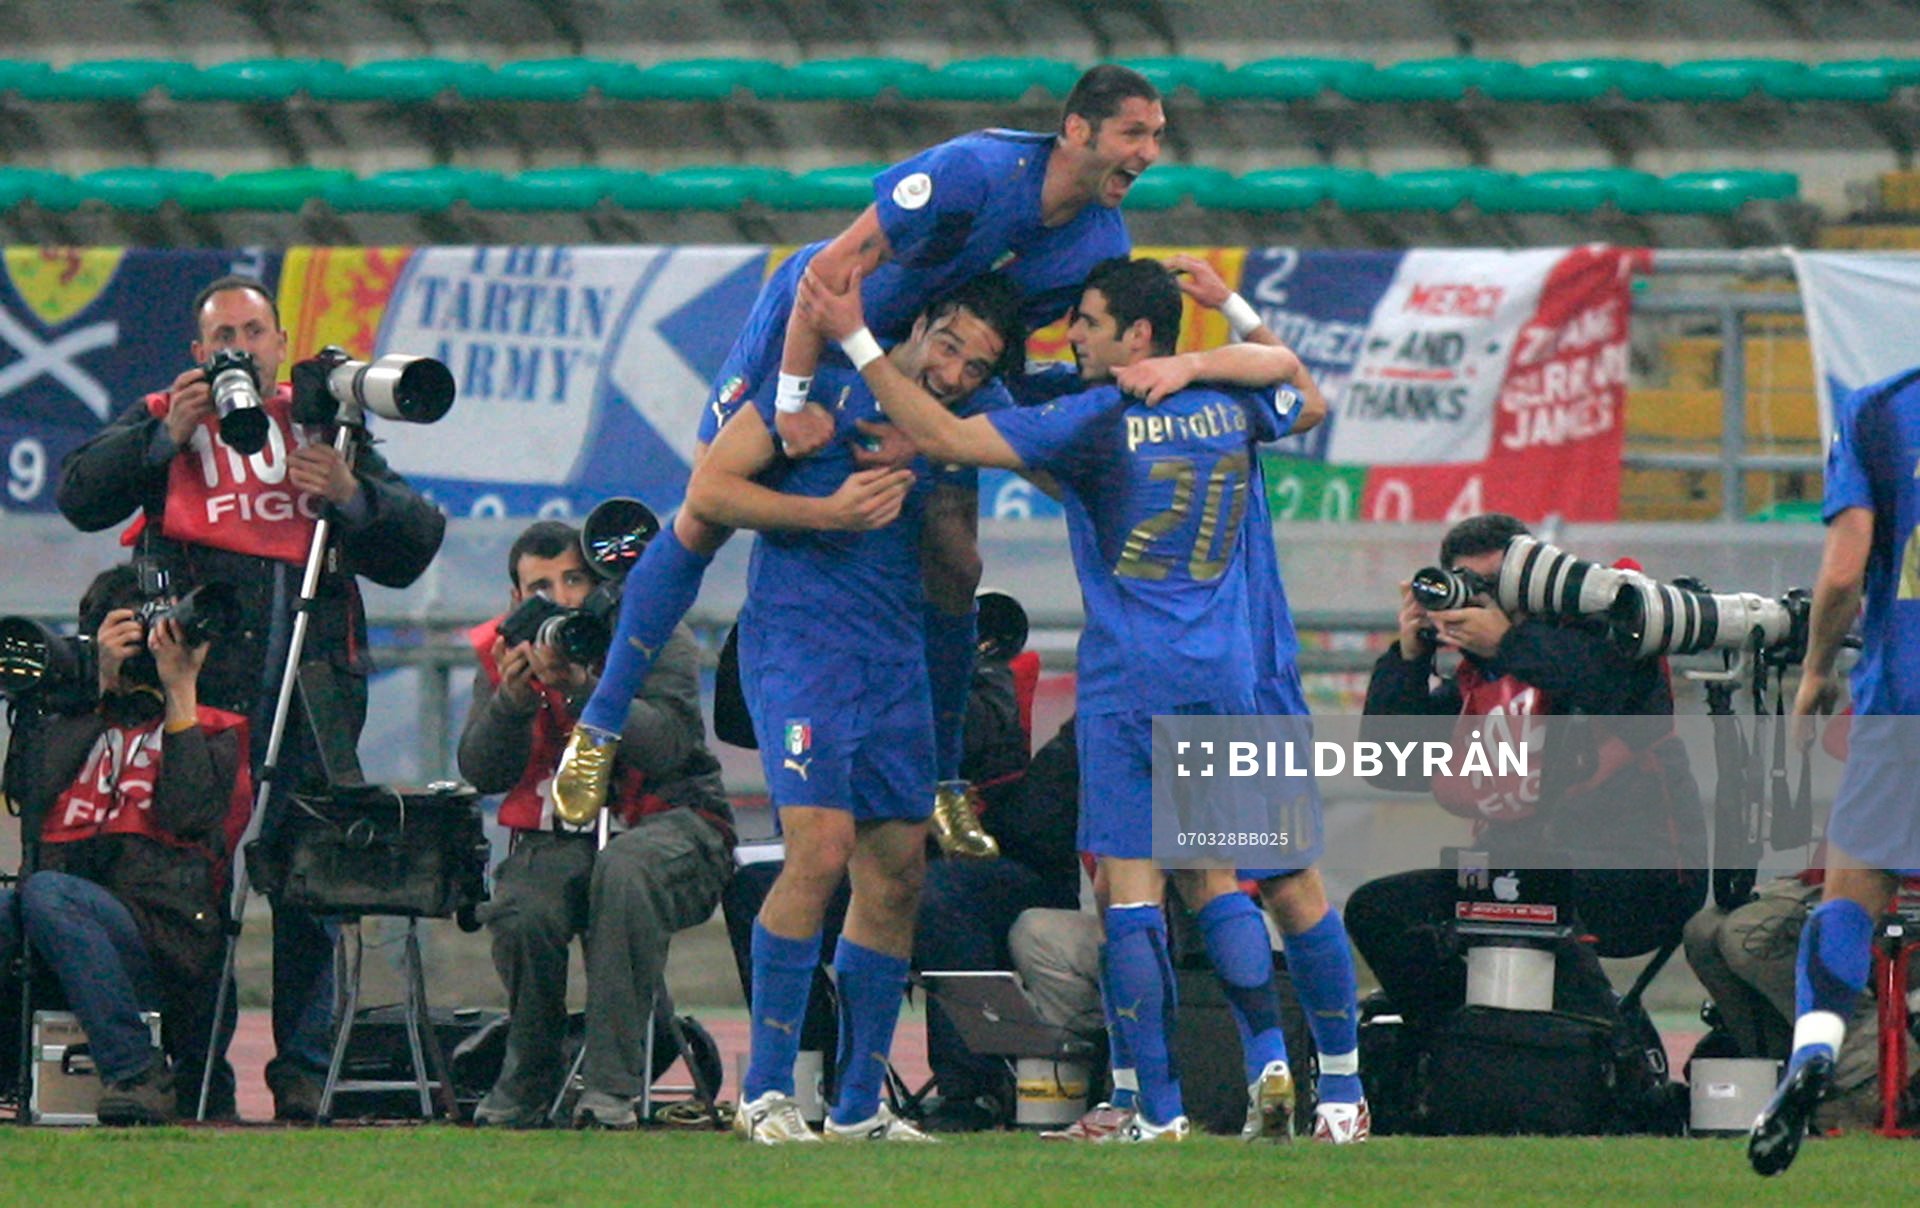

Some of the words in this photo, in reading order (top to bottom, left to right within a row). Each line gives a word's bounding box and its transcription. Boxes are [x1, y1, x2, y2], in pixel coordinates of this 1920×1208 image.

[1254, 247, 1299, 304] 2
[416, 274, 614, 340] TARTAN
[1393, 329, 1466, 368] AND
[1342, 381, 1468, 423] THANKS
[7, 438, 47, 501] 9
[1112, 455, 1251, 582] 20
